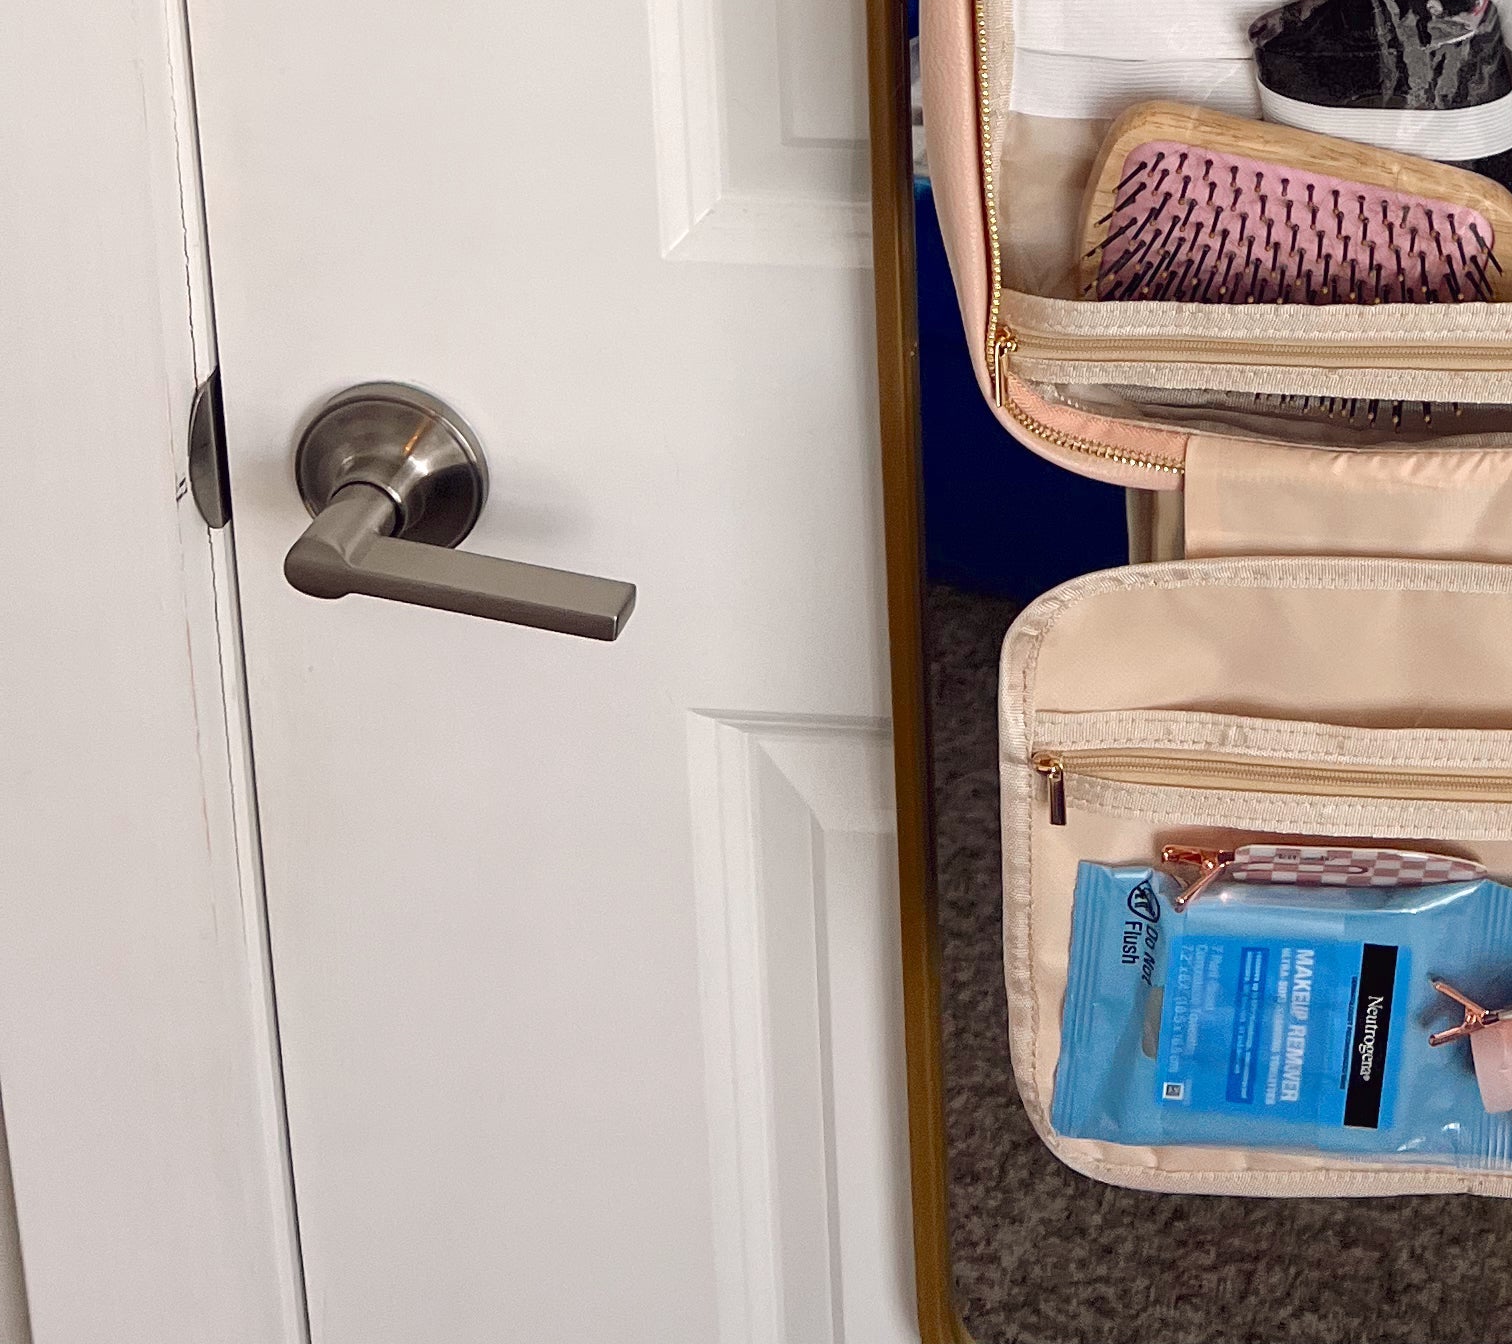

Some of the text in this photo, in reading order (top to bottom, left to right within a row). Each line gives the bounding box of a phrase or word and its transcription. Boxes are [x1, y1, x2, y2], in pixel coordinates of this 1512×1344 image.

[1121, 920, 1143, 965] Flush
[1141, 924, 1159, 986] Do Not
[1289, 948, 1315, 1021] MAKEUP
